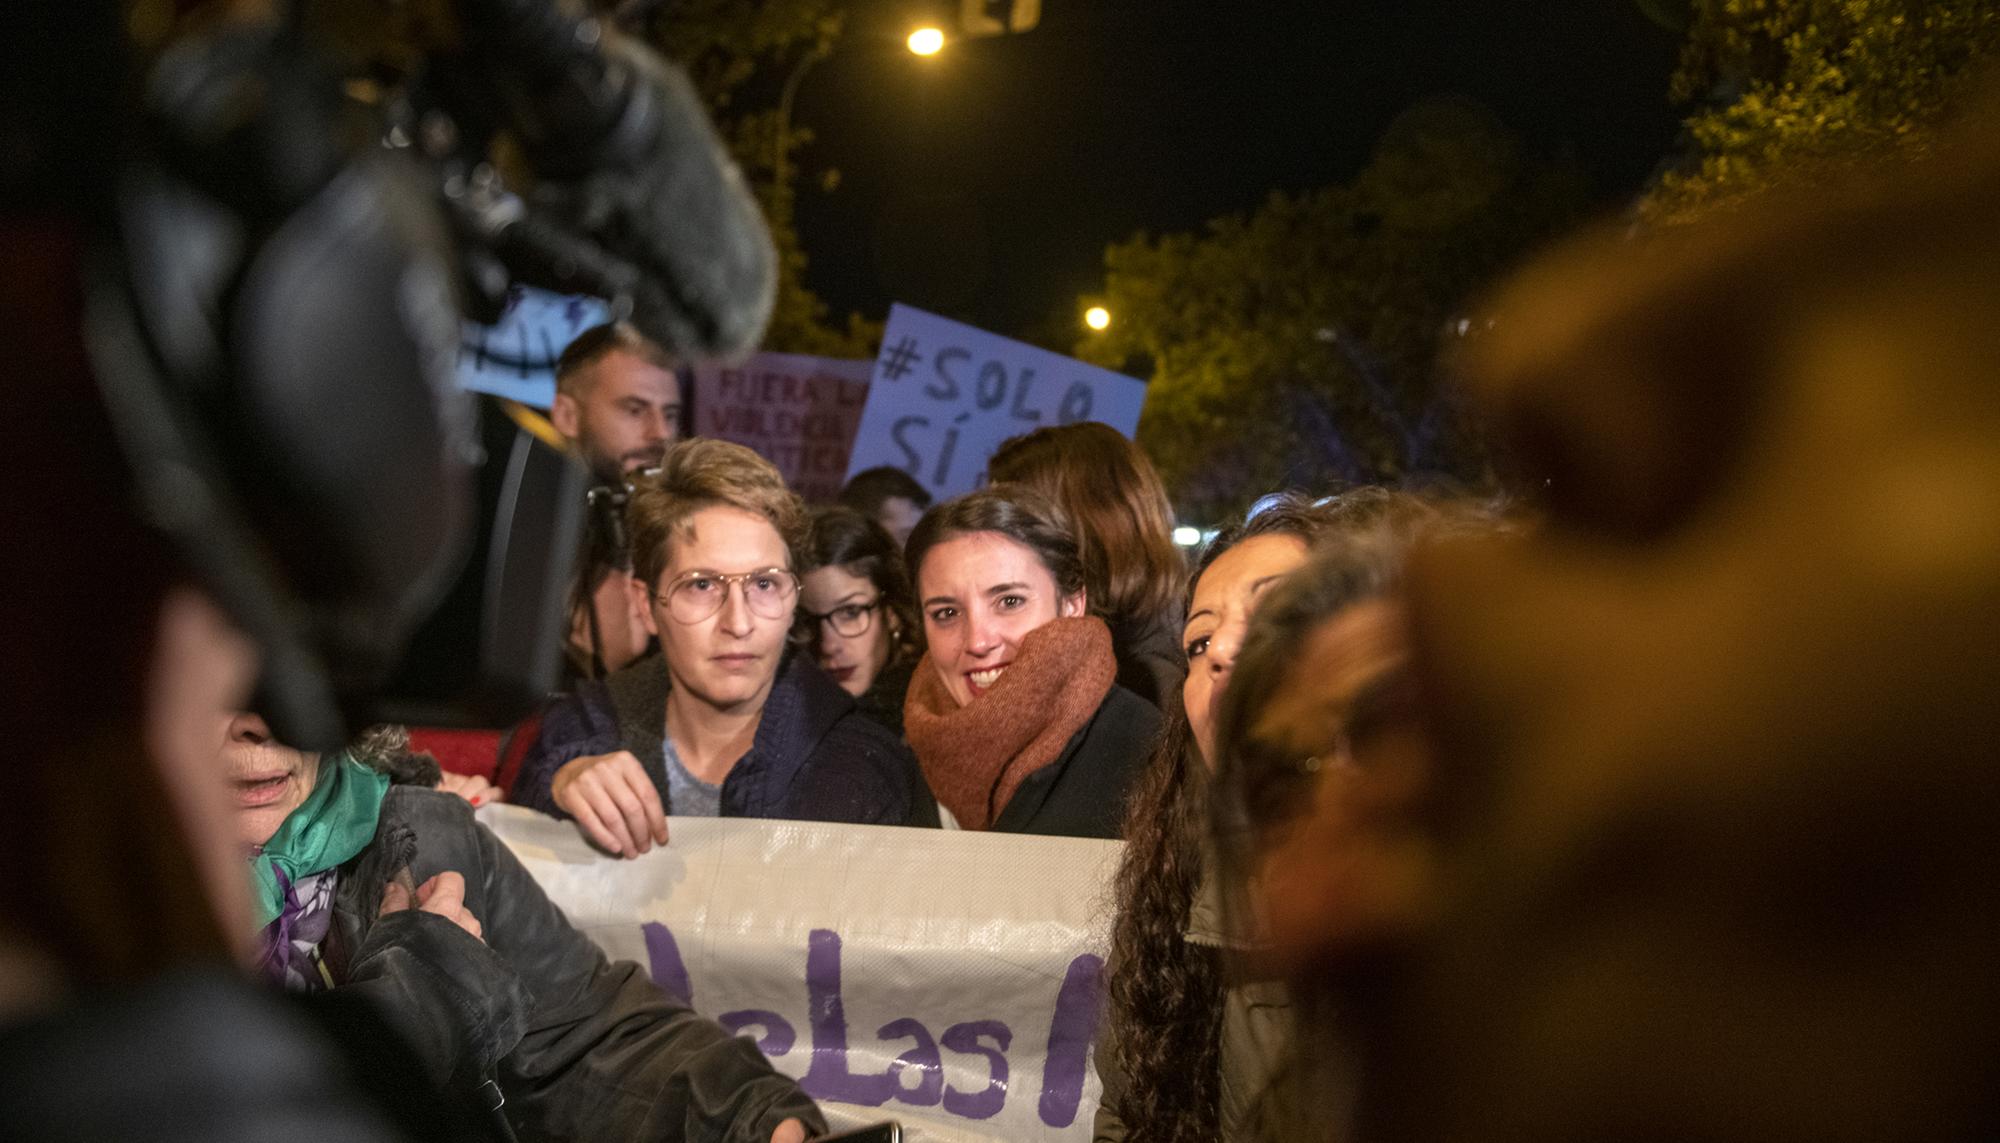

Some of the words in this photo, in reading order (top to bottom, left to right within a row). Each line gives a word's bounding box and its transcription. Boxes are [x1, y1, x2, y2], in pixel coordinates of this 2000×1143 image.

[719, 368, 820, 402] FUERA
[881, 335, 1095, 425] #SOLO
[890, 411, 972, 487] SÍ
